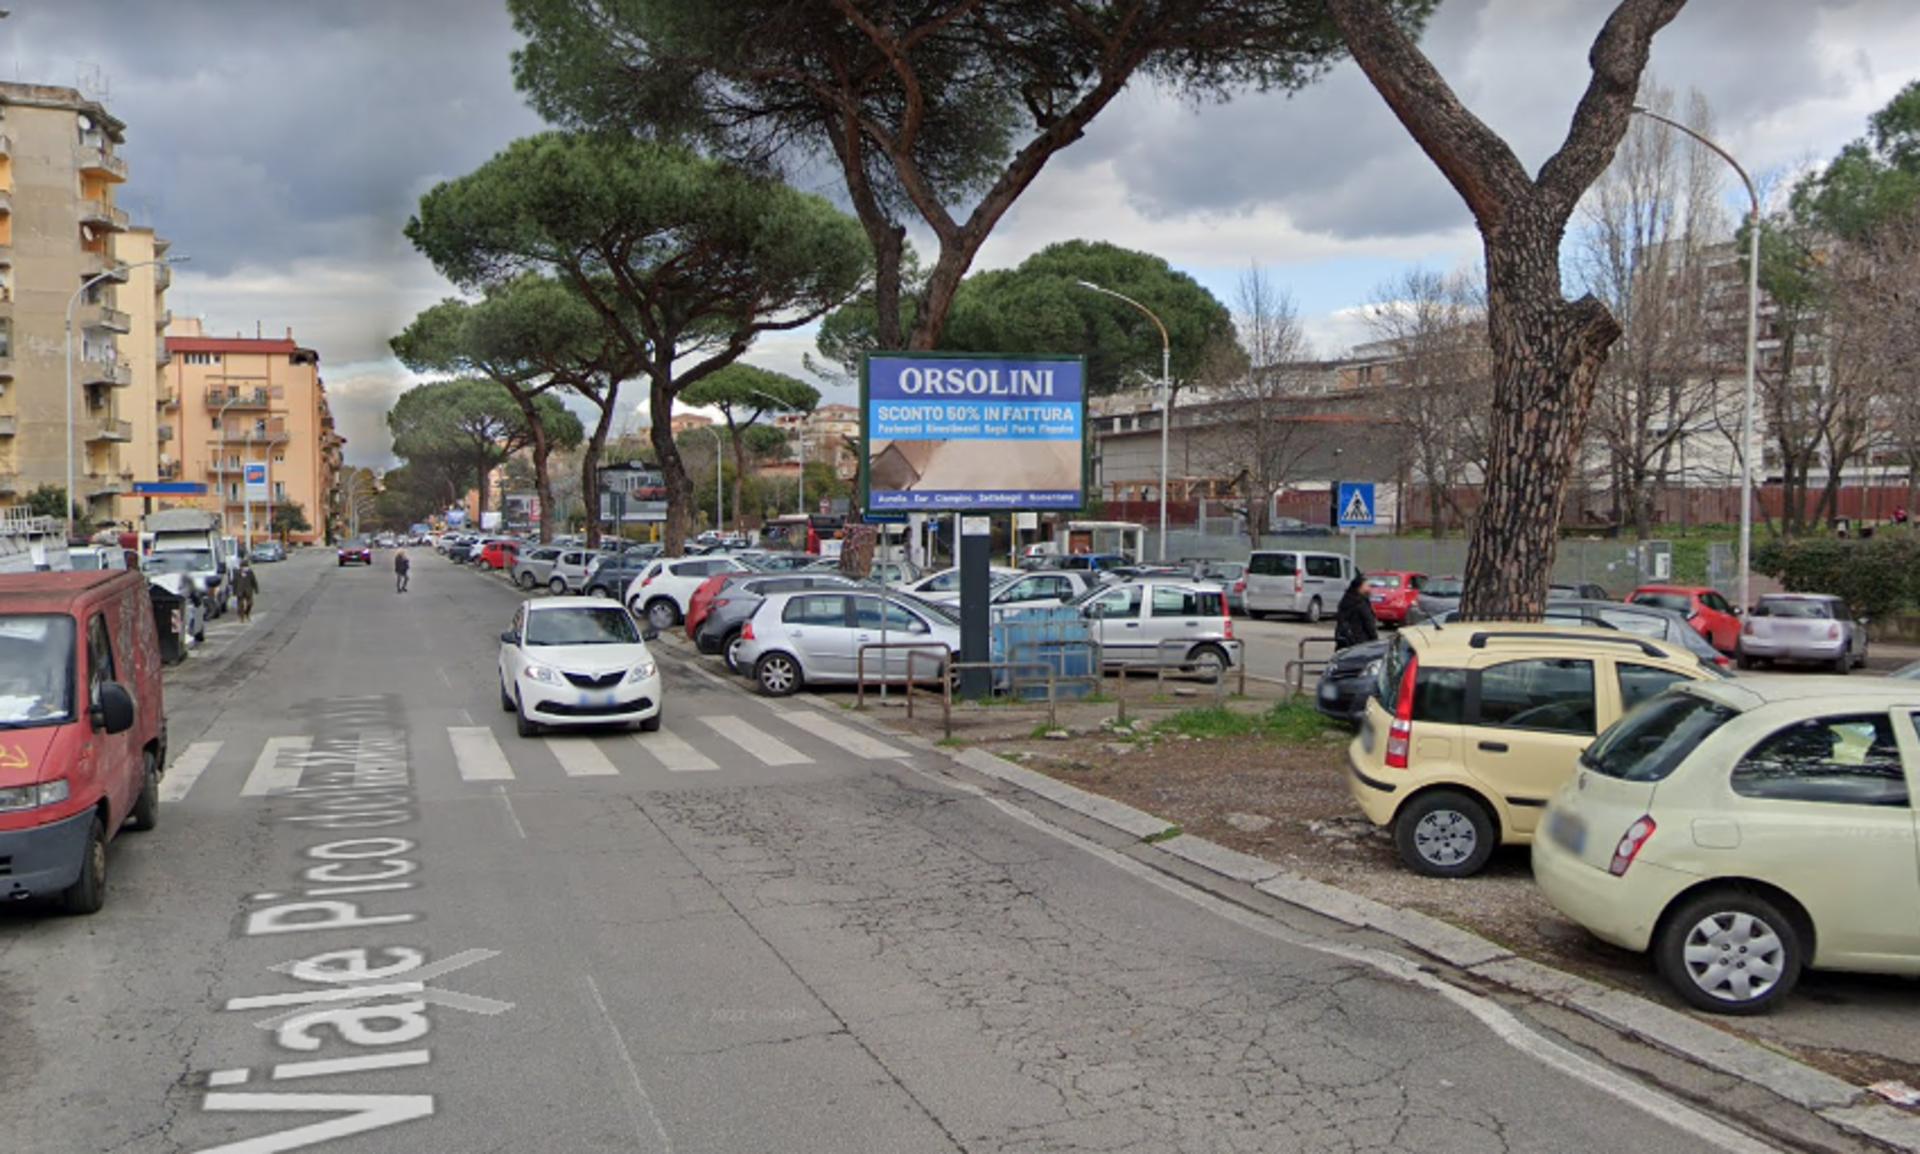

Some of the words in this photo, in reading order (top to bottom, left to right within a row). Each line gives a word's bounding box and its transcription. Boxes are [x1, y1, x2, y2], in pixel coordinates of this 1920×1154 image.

[898, 366, 1054, 396] ORSOLINI
[878, 406, 943, 421] SCONTO
[984, 407, 1001, 421] IN
[1002, 407, 1074, 421] FATTURA
